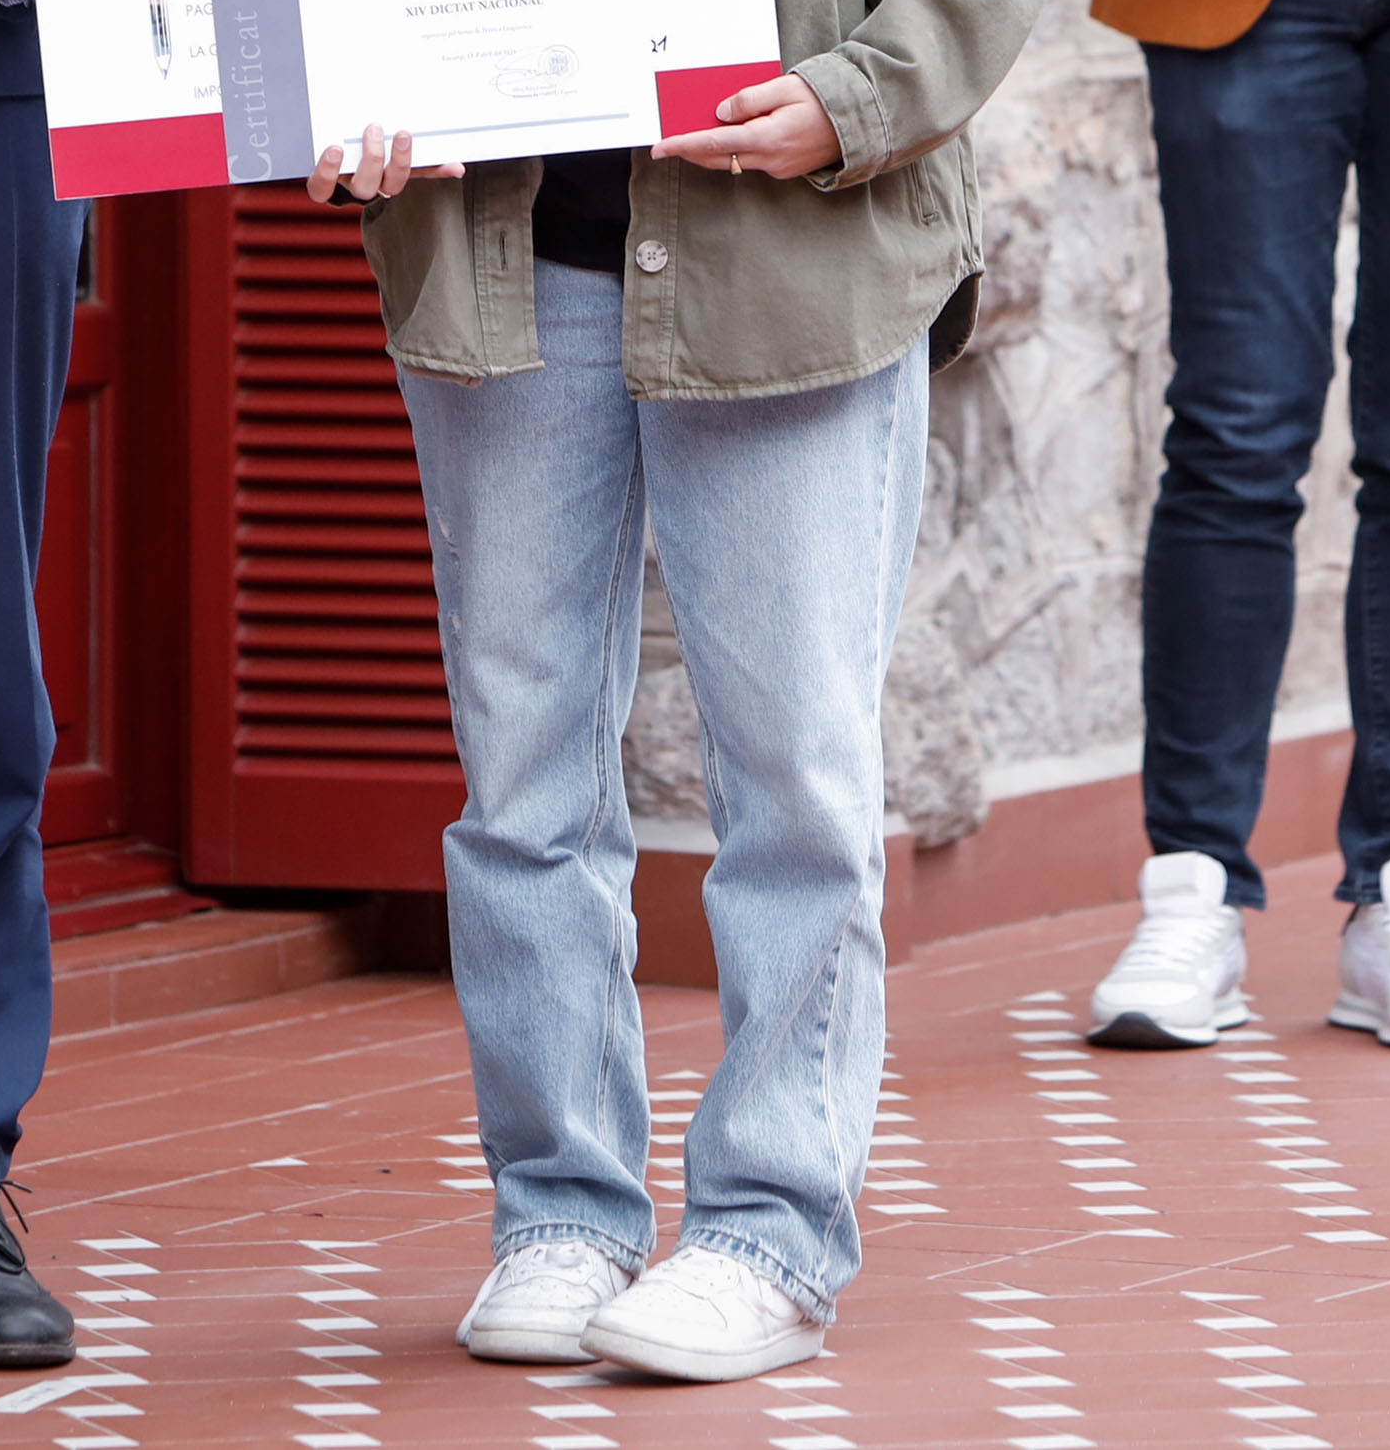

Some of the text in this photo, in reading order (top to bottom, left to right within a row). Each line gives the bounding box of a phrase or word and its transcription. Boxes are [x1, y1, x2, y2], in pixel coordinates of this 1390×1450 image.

[405, 6, 427, 18] XIV
[430, 1, 477, 15] DICTAT
[190, 46, 206, 58] LA
[228, 10, 272, 184] Certificat
